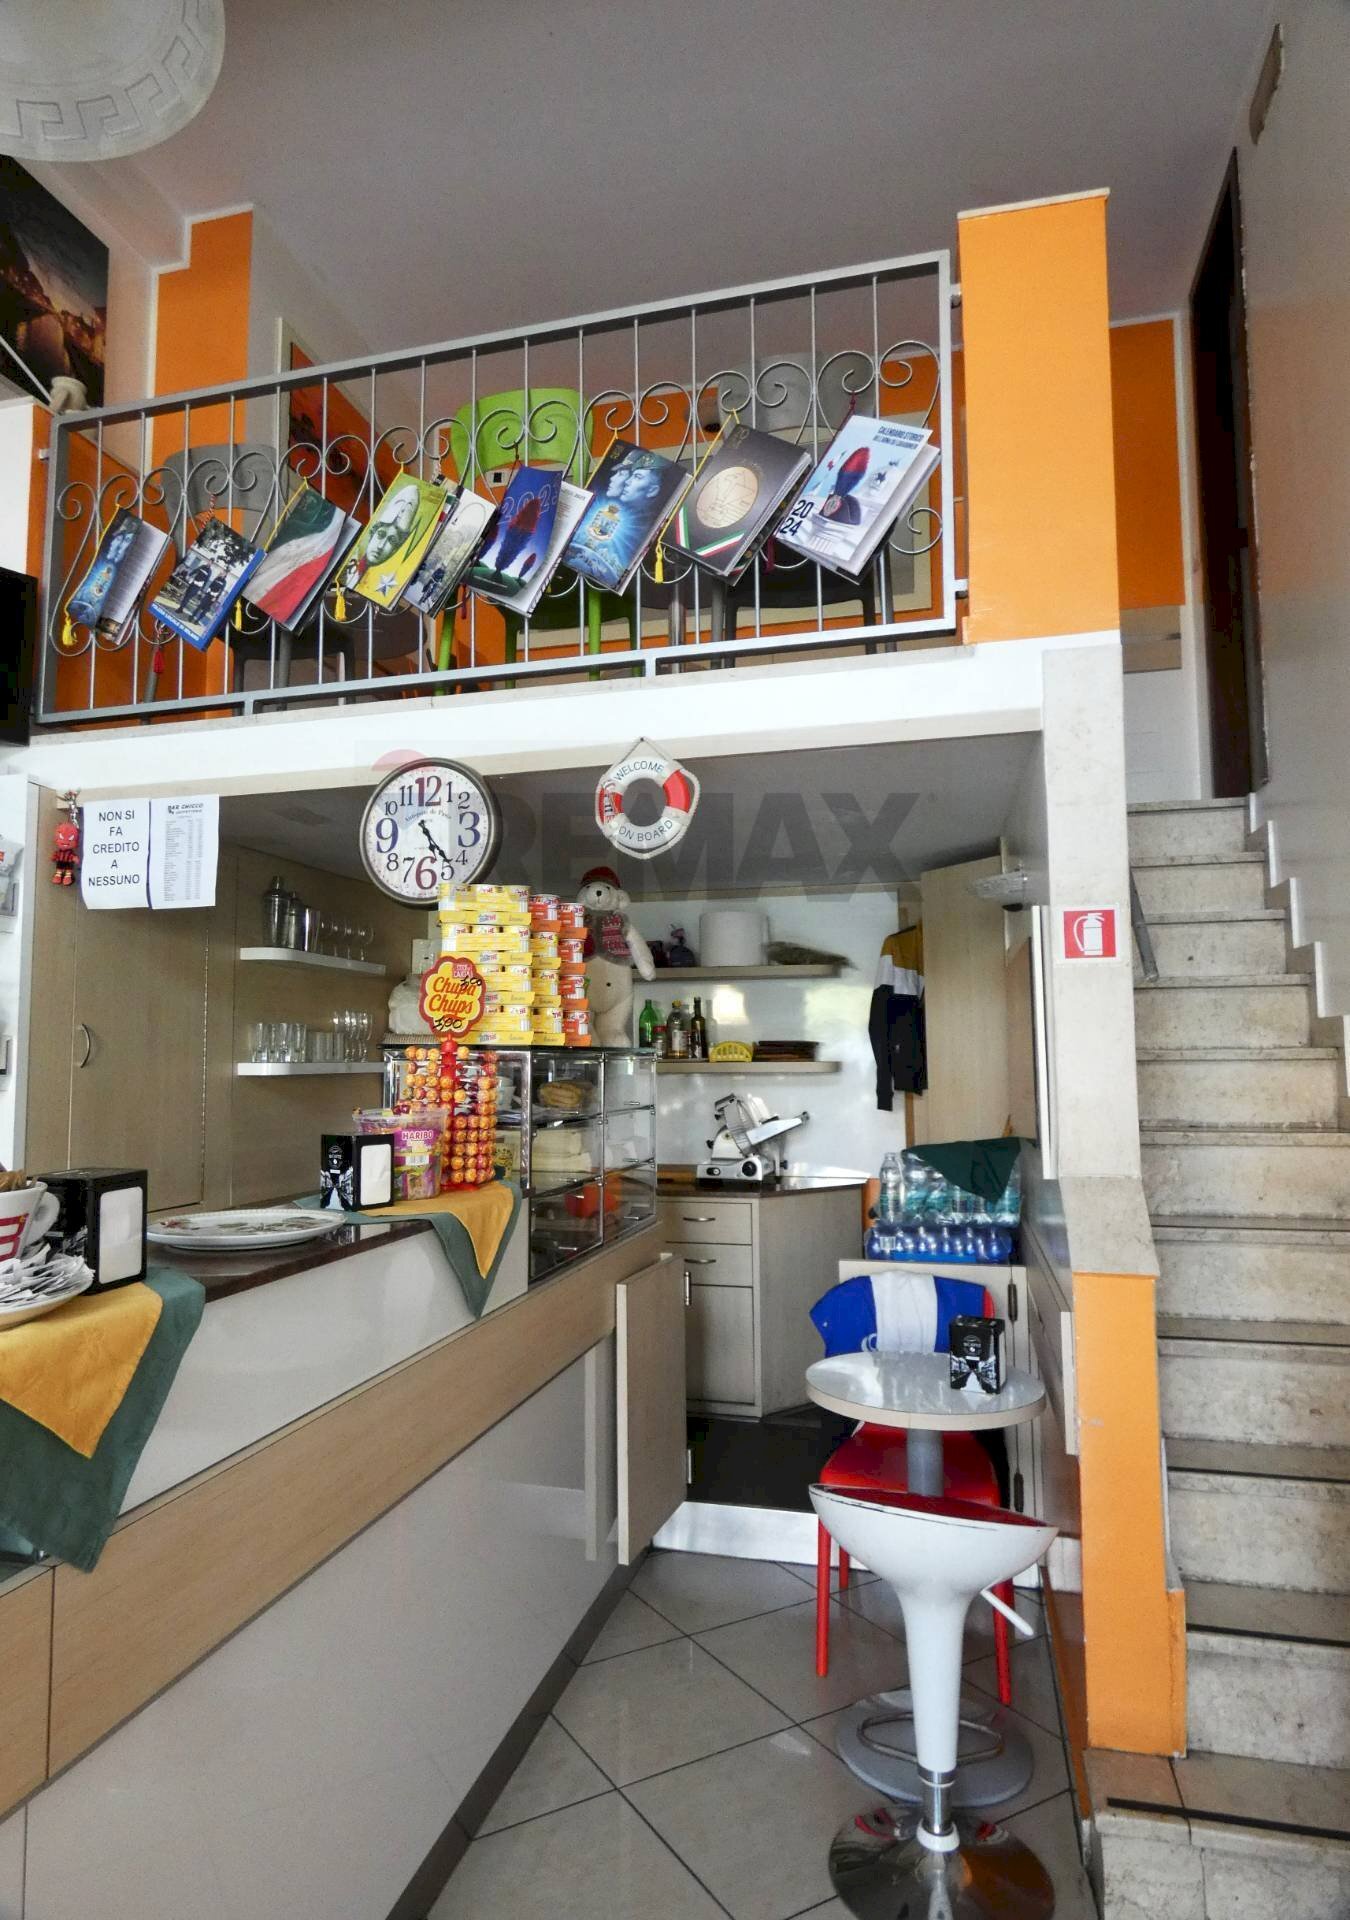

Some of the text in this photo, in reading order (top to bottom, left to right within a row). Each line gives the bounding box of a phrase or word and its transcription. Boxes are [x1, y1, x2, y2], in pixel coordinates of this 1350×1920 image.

[791, 499, 814, 519] 20
[779, 517, 803, 537] 24
[614, 760, 665, 781] WELCOME
[401, 785, 413, 806] 11
[415, 775, 442, 807] 12
[446, 781, 453, 803] 1
[458, 792, 470, 809] 2
[99, 810, 135, 822] NON SI
[385, 801, 398, 815] 10
[109, 826, 123, 837] FA
[375, 818, 399, 854] 9
[457, 811, 481, 848] 3
[619, 819, 673, 842] ON BOARD
[92, 841, 140, 854] CREDITO
[455, 850, 468, 865] 4
[110, 859, 118, 869] A
[387, 853, 399, 871] 8
[402, 857, 416, 883] 7
[441, 858, 455, 881] 5
[88, 874, 140, 887] NESSUNO
[415, 856, 438, 890] 6
[433, 976, 476, 999] Chupa
[429, 993, 473, 1016] Chups
[402, 1130, 434, 1140] HARIBO
